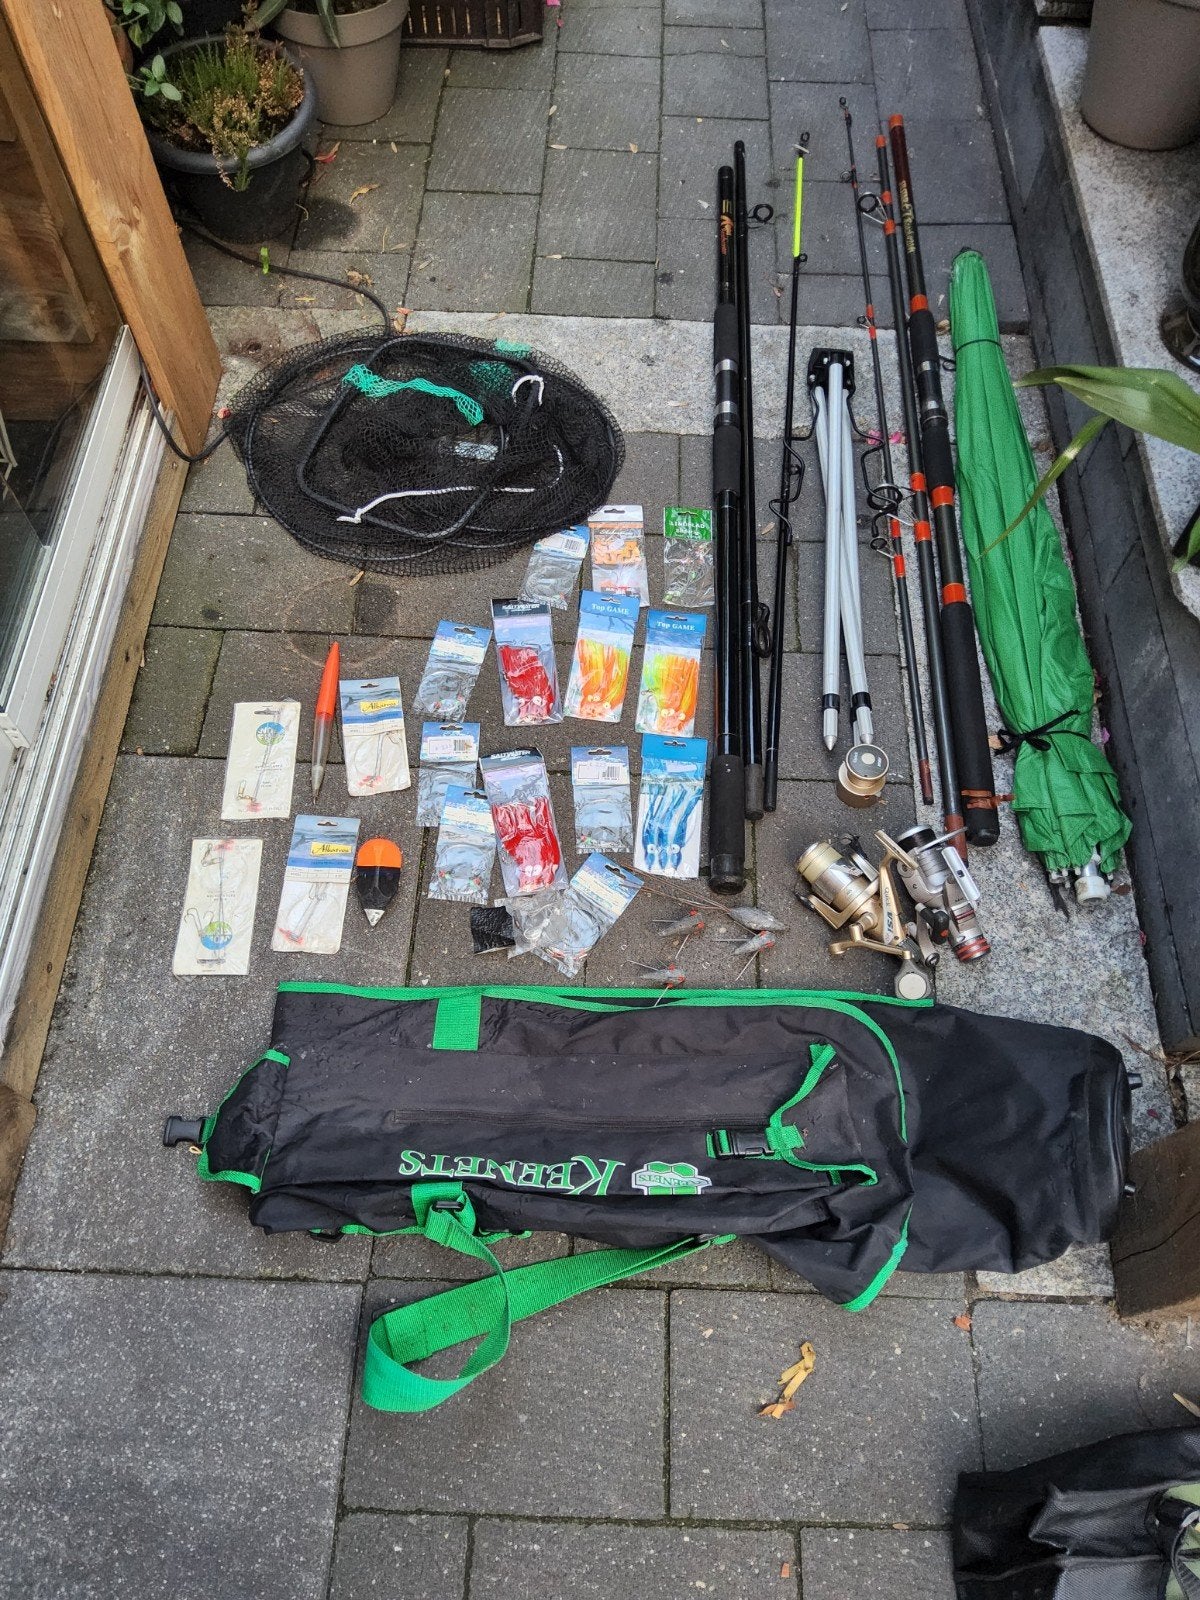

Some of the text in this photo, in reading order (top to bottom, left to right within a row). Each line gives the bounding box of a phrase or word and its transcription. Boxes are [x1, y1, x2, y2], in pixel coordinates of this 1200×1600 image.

[591, 602, 630, 615] Top GAME
[657, 621, 695, 631] Top GAME
[398, 1150, 626, 1196] KEENETS
